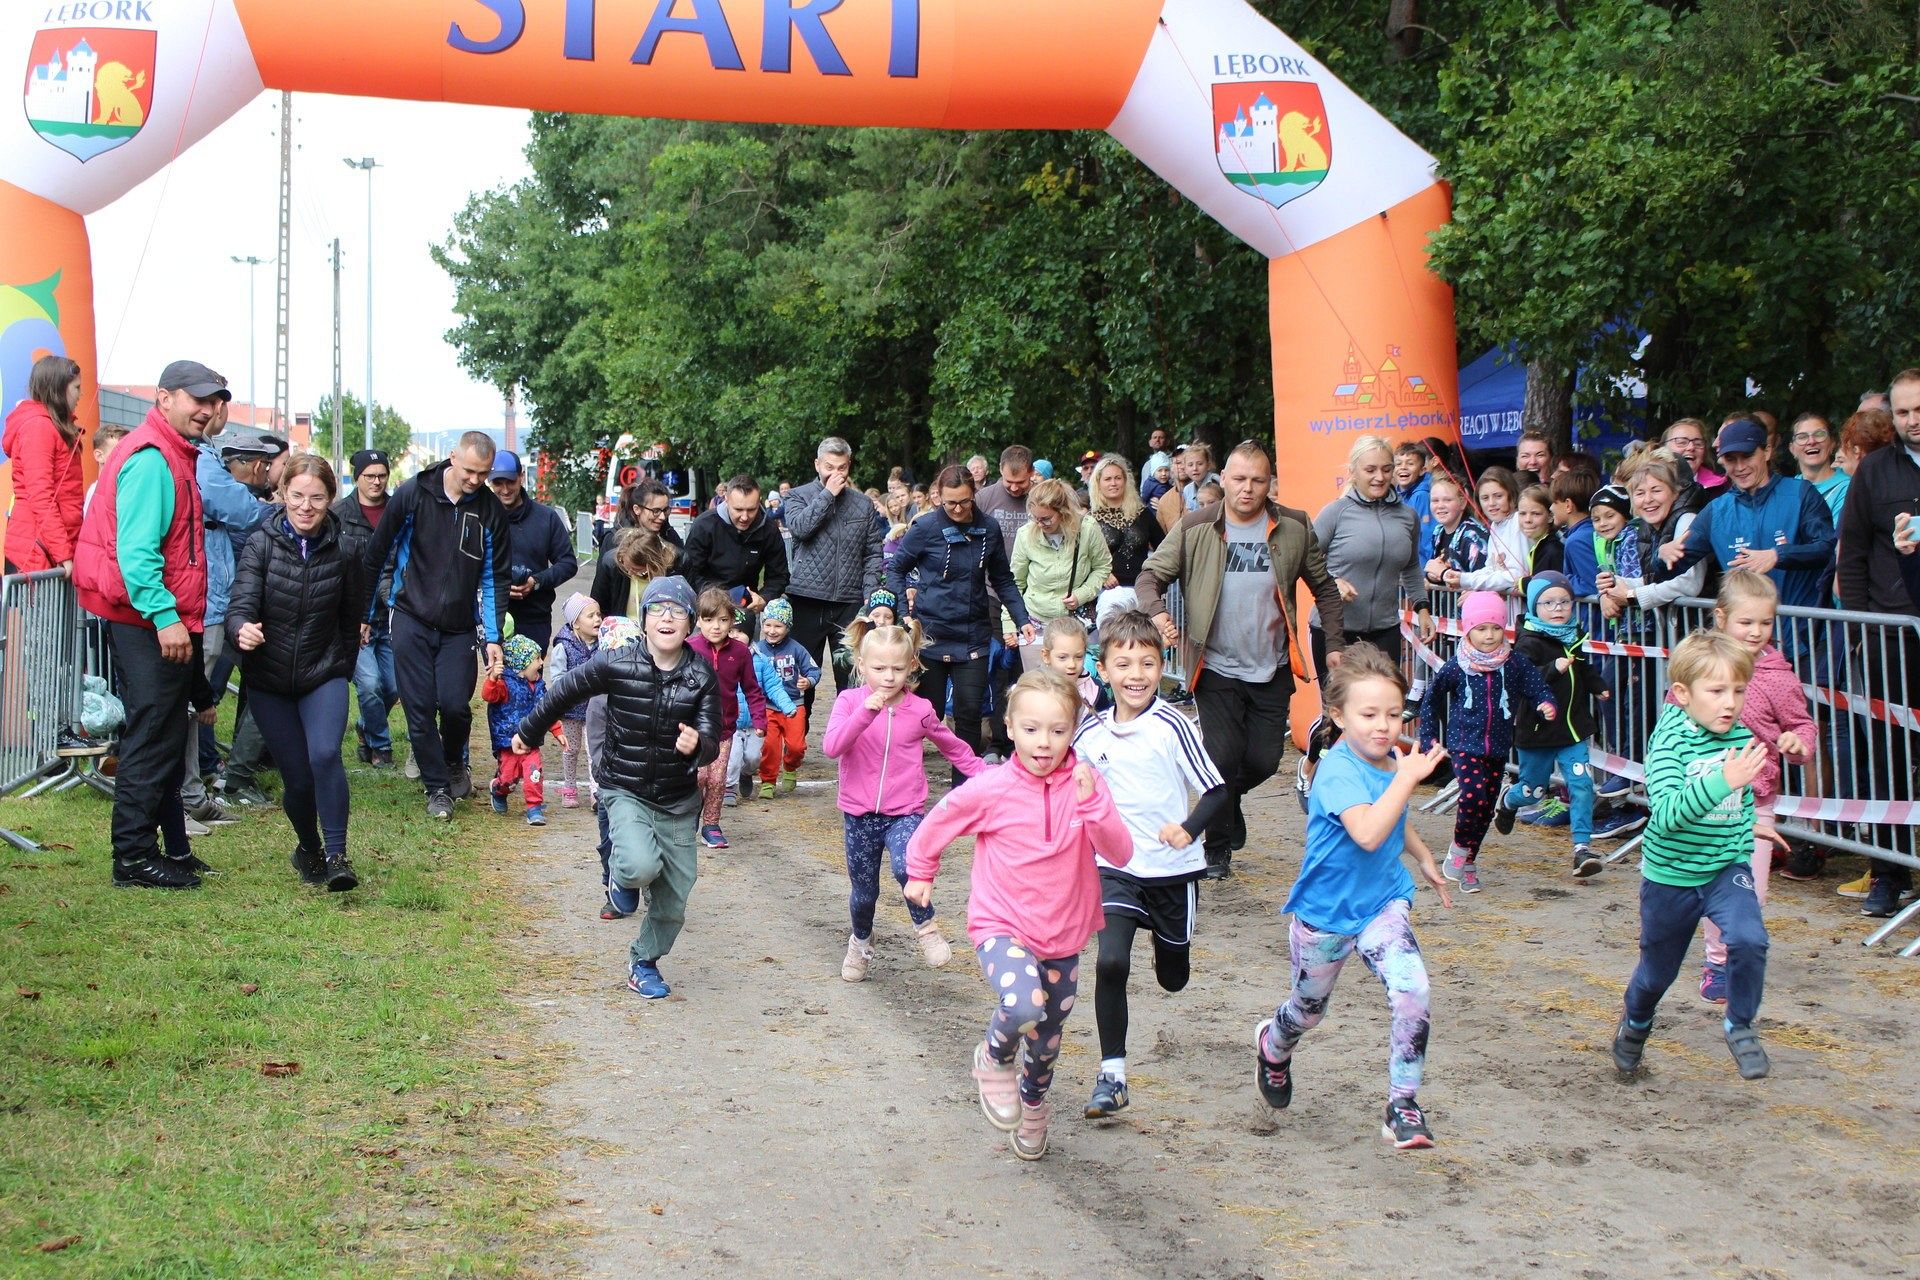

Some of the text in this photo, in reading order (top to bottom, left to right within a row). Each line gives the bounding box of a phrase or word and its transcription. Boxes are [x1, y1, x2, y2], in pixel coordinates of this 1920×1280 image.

[44, 0, 153, 24] LĘBORK
[1213, 54, 1311, 79] LĘBORK
[870, 597, 895, 607] ONLY
